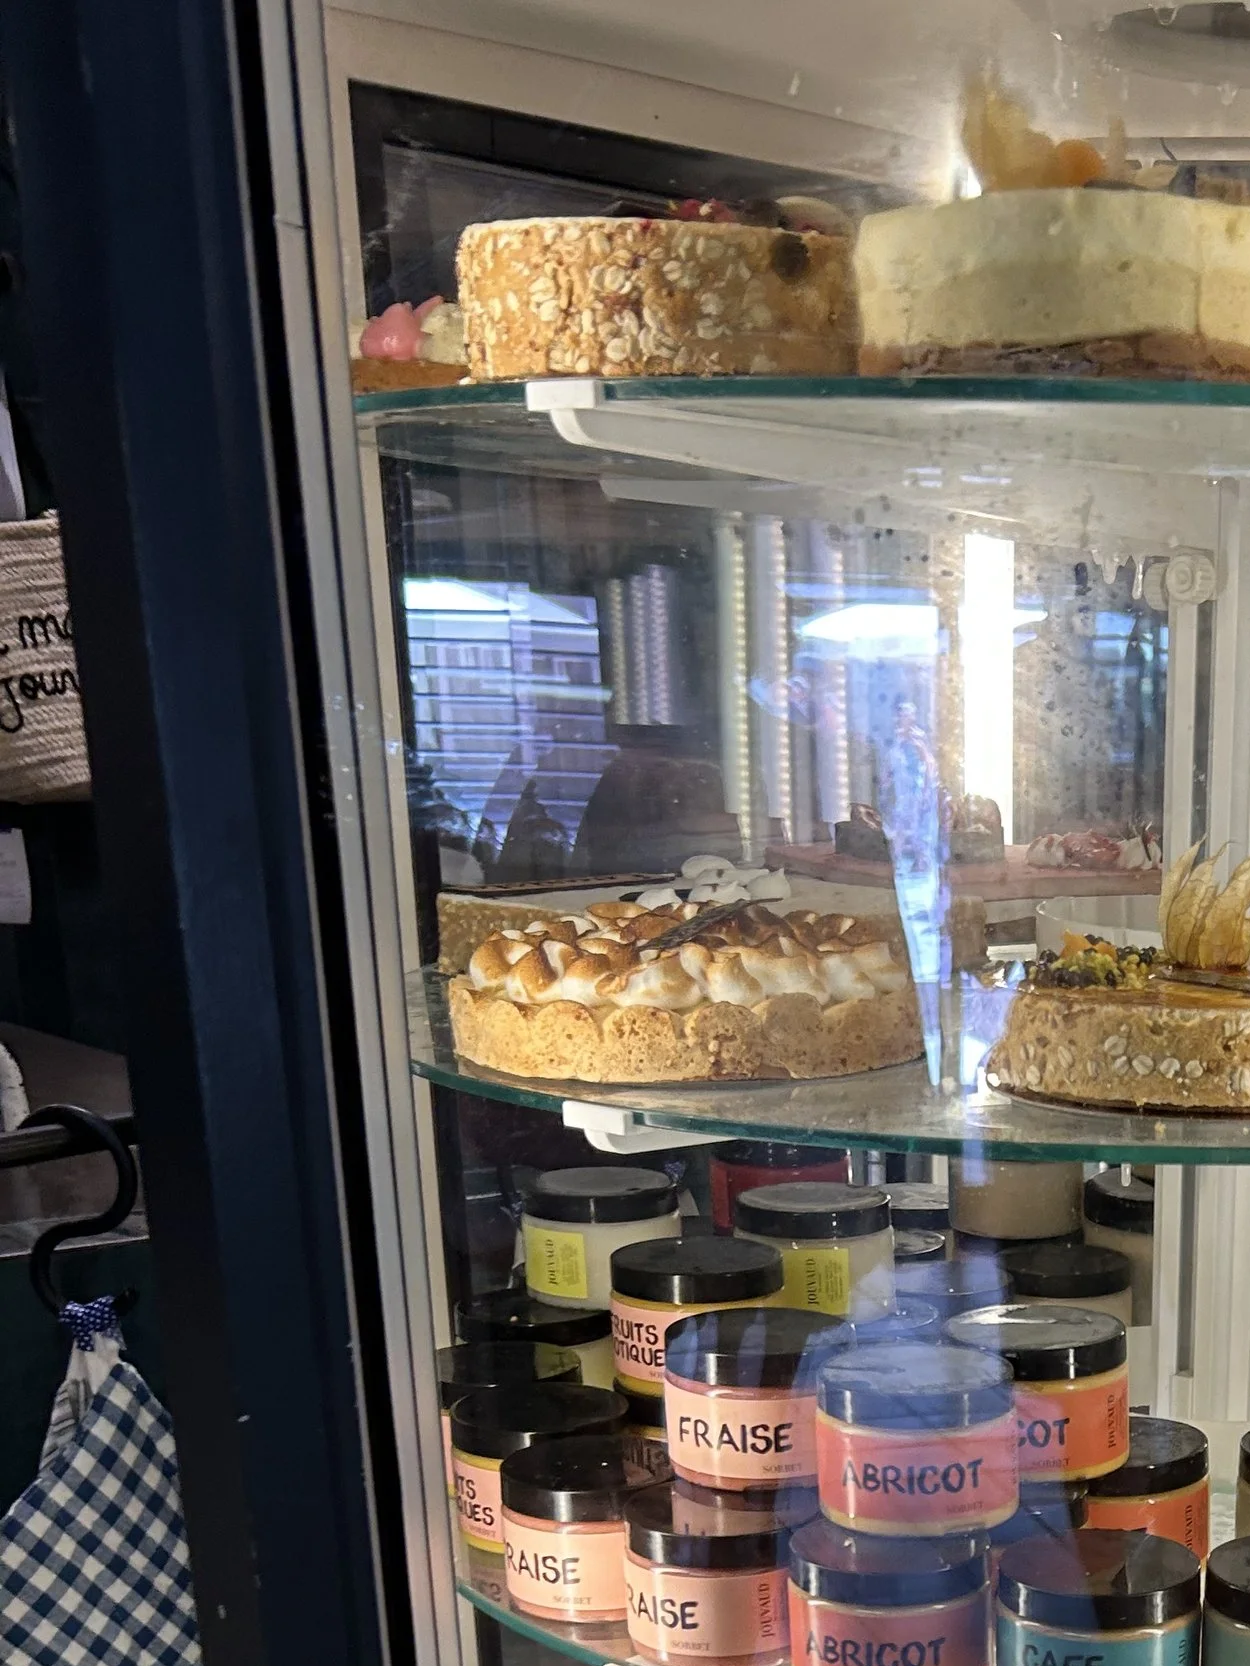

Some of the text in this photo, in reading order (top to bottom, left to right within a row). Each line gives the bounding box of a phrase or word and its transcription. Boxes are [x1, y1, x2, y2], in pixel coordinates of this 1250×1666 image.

[806, 1258, 820, 1305] JOUVAUD
[679, 1416, 793, 1455] FRAISE
[1107, 1394, 1117, 1449] JOUVAUD
[842, 1458, 984, 1496] ABRICOT
[756, 1582, 777, 1638] JOUVAUD
